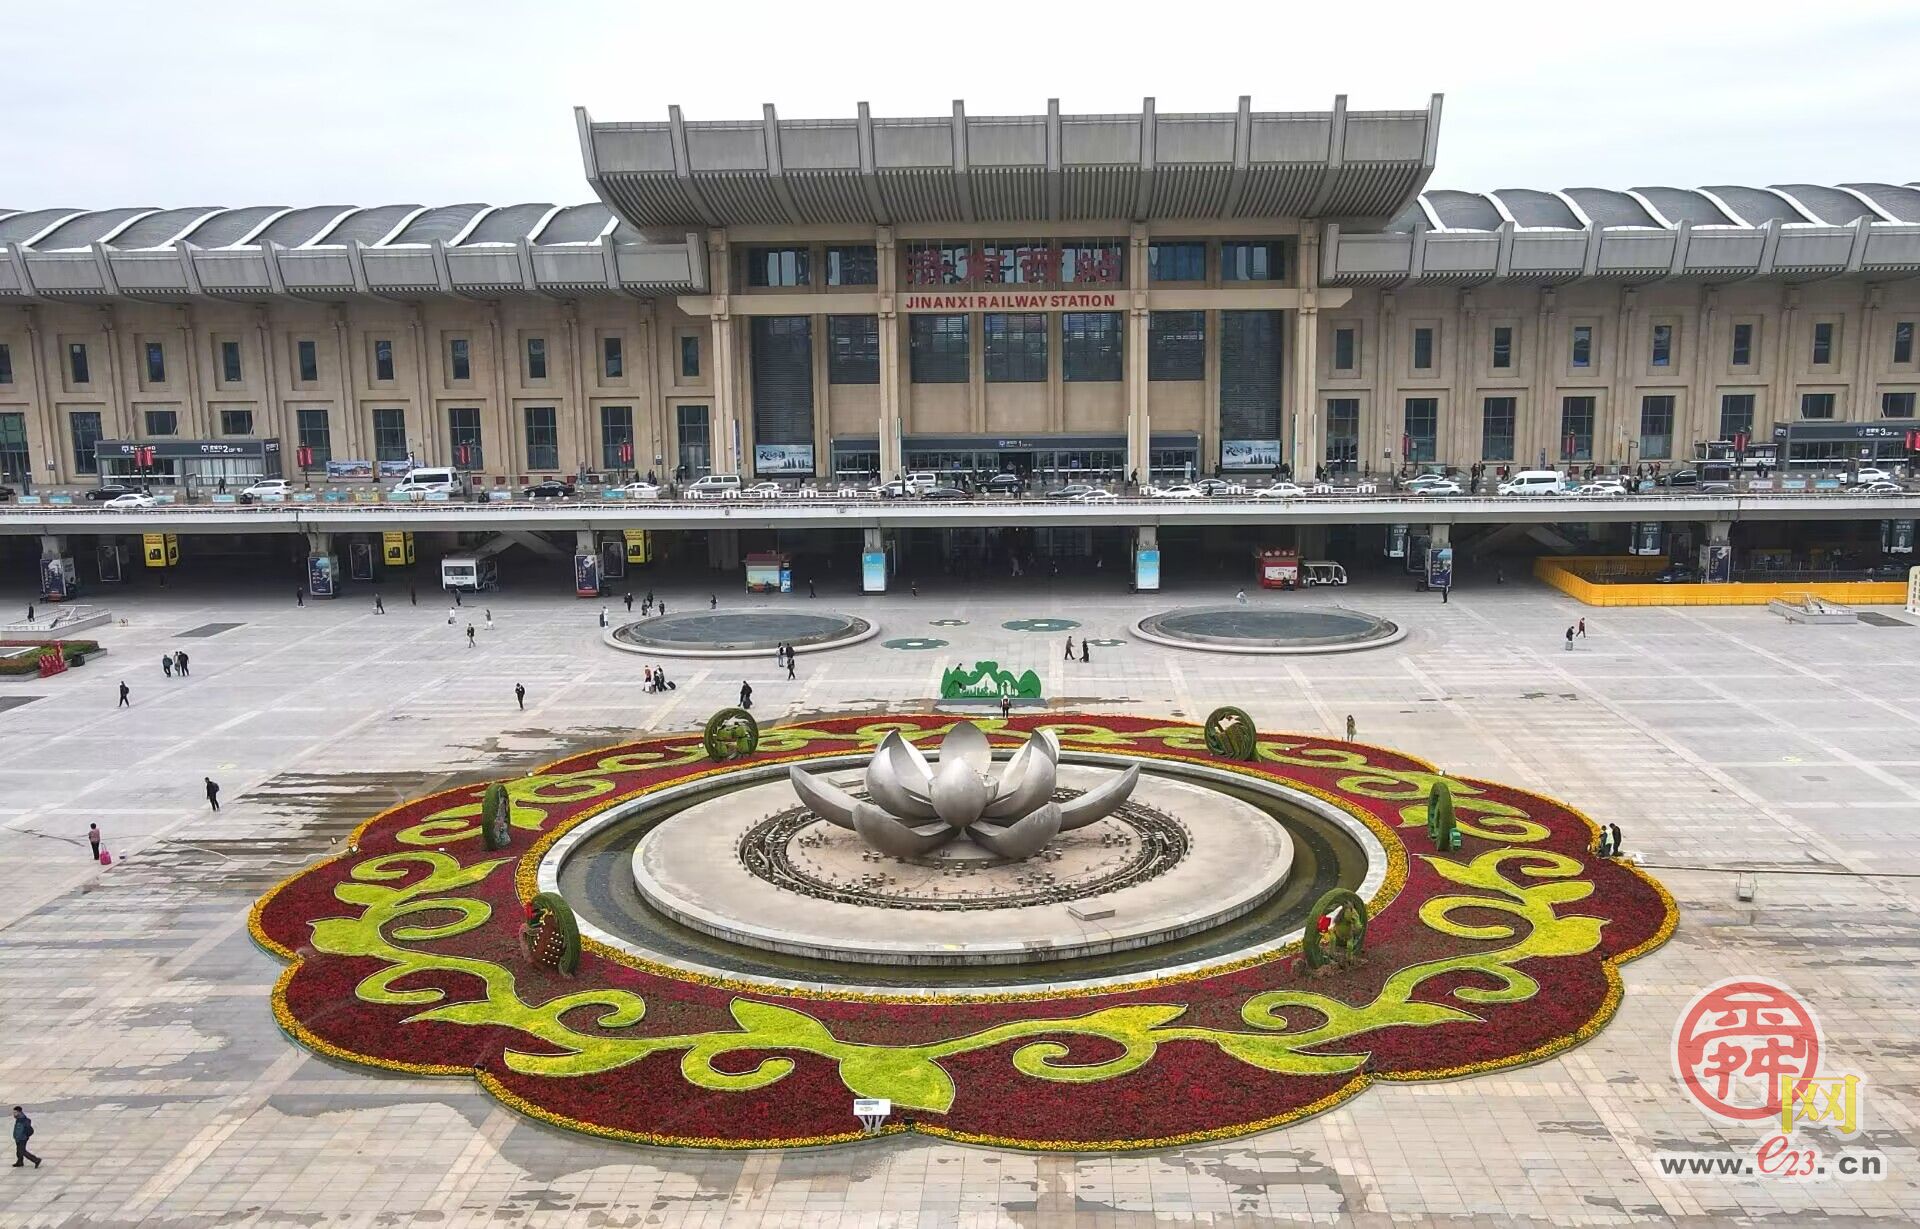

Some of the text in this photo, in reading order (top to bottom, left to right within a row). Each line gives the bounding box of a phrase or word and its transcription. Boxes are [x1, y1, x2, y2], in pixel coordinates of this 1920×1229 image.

[906, 294, 1115, 309] JINANXI RAILWAY STATION
